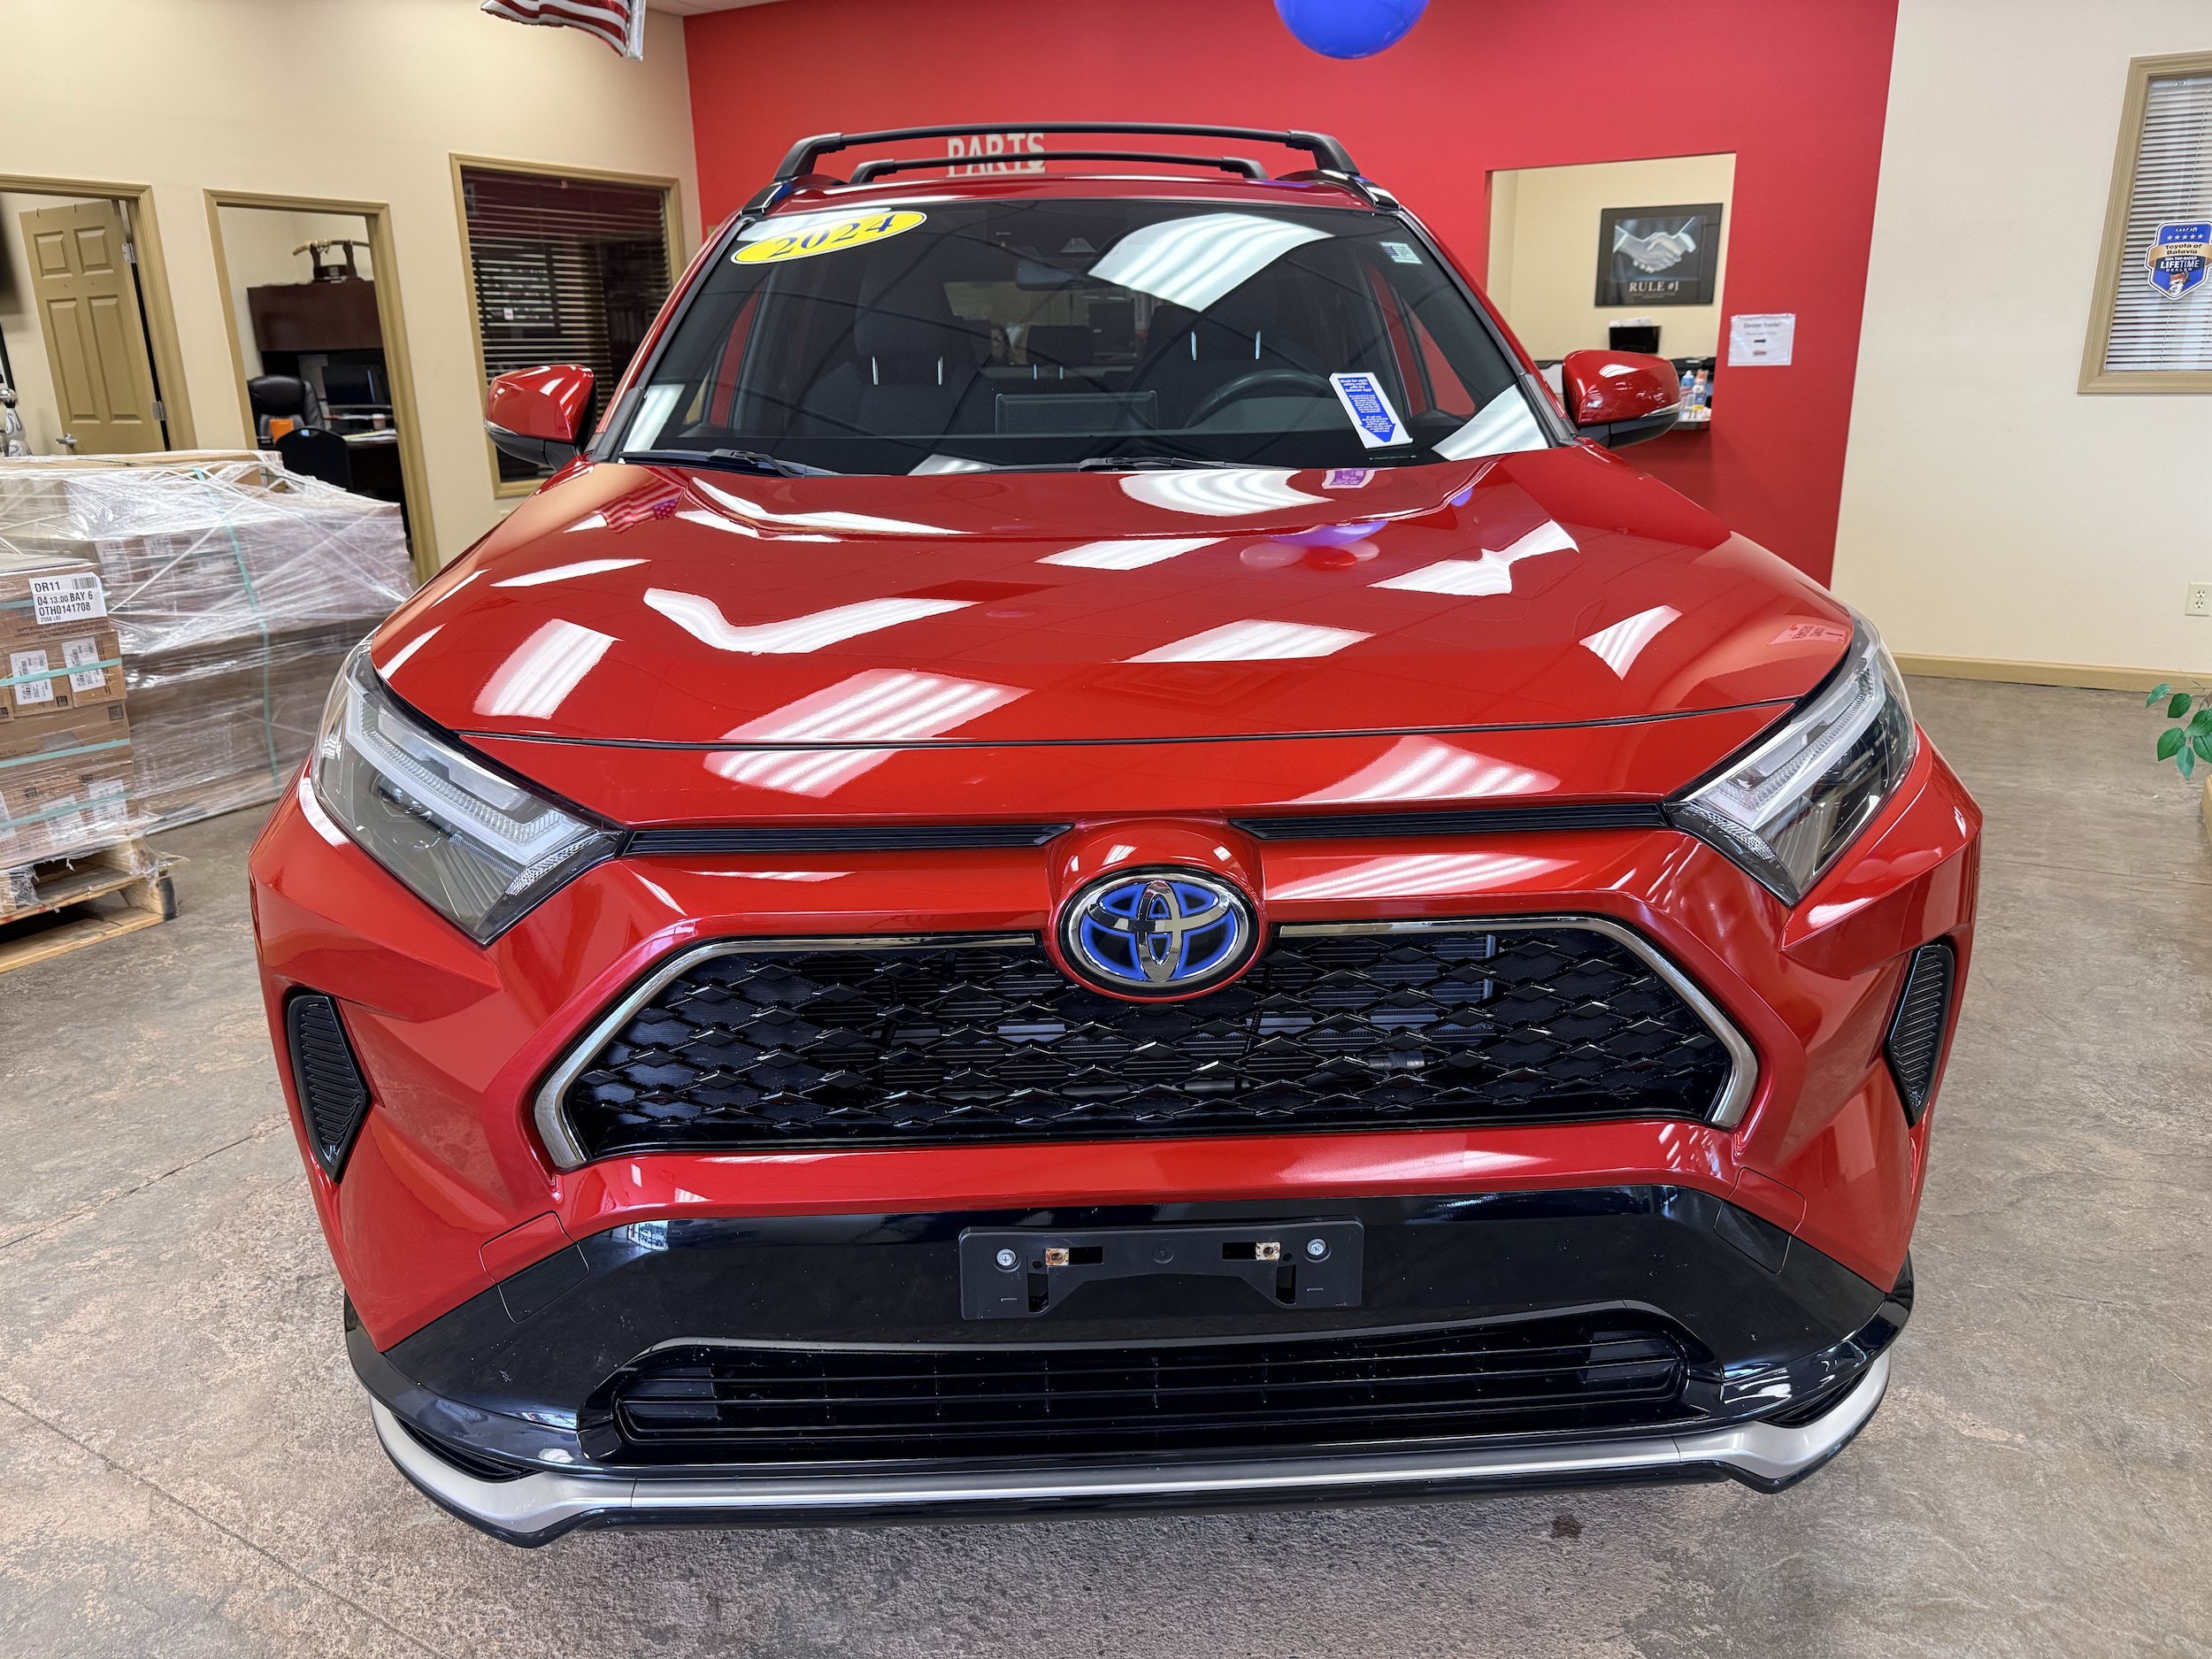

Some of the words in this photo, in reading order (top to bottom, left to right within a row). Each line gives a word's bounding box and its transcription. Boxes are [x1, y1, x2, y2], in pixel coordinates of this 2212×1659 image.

[947, 133, 1046, 178] PARTS
[767, 213, 896, 258] 2024
[2160, 260, 2200, 269] LIFETIME
[1629, 280, 1665, 292] RULE
[35, 580, 60, 593] DR11
[37, 595, 48, 606] 04
[50, 595, 69, 604] 13:00
[70, 591, 85, 602] BAY
[88, 590, 94, 601] 6
